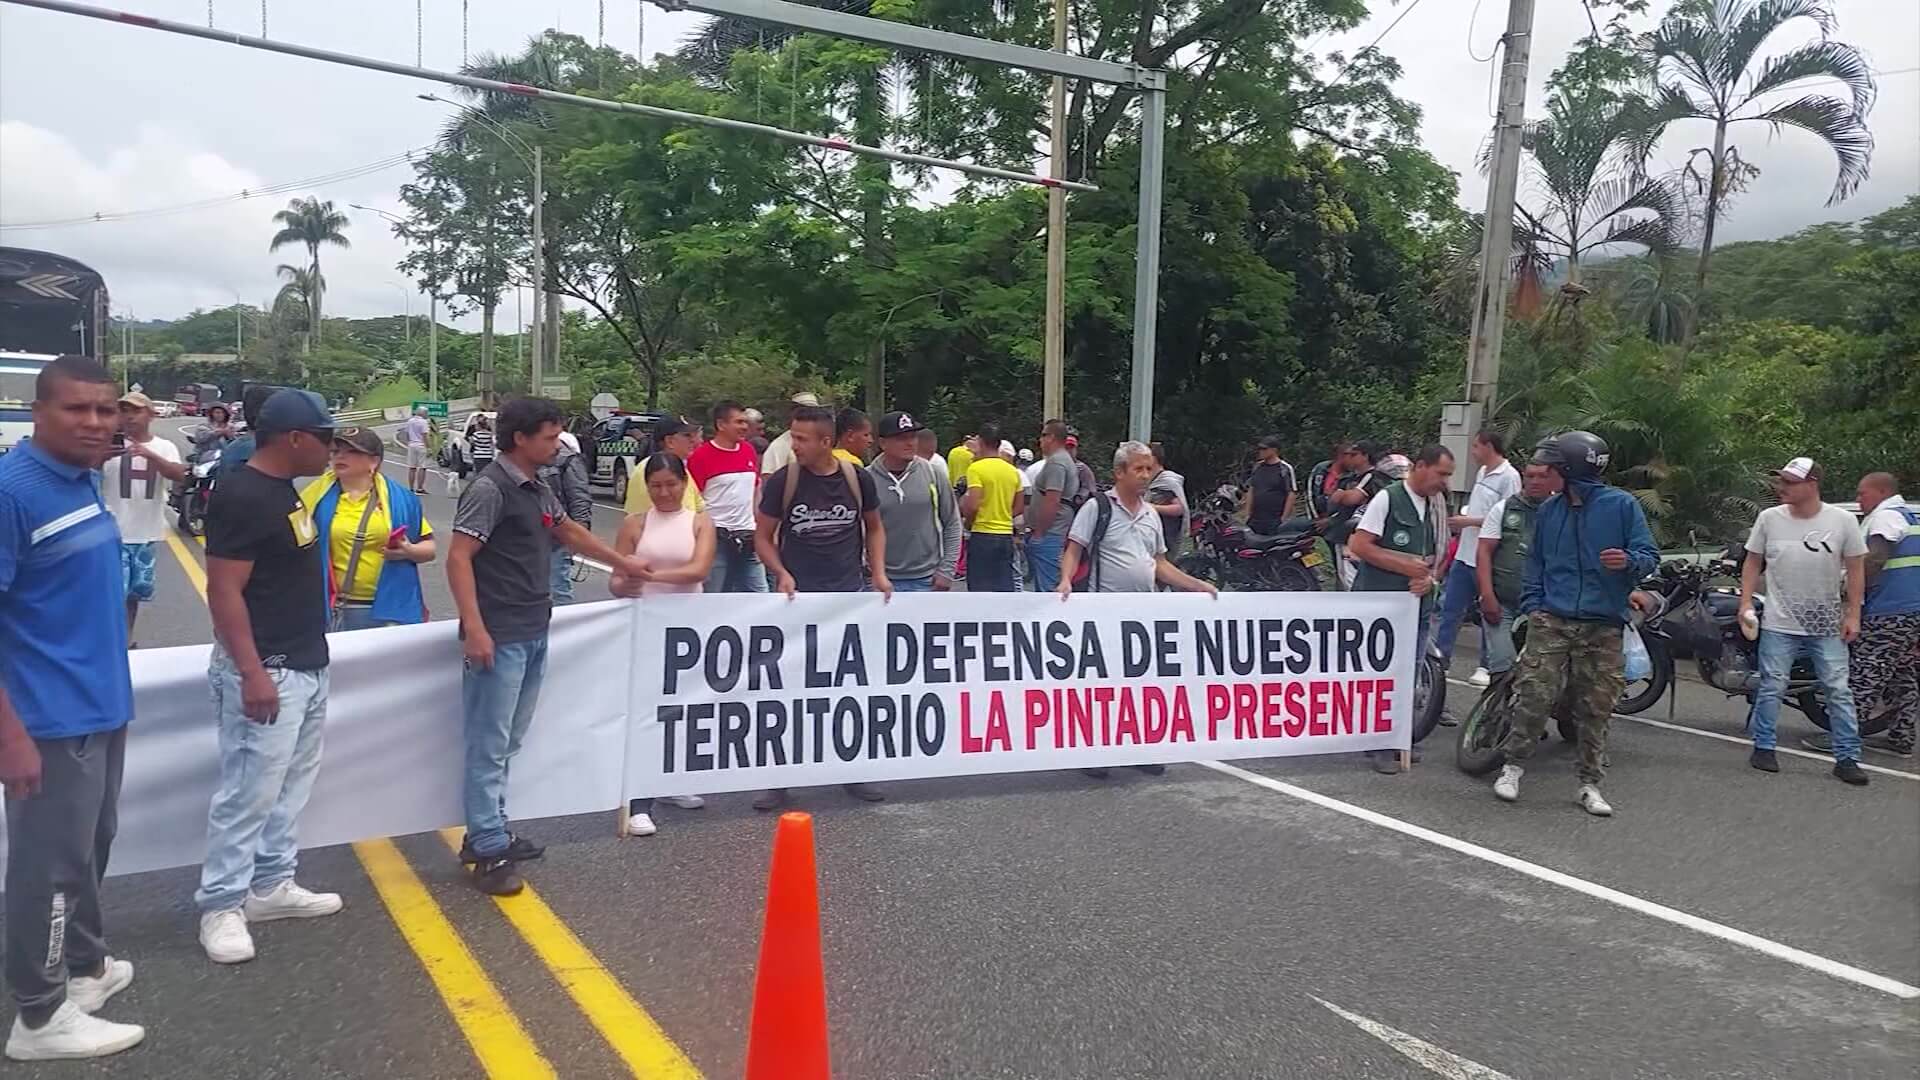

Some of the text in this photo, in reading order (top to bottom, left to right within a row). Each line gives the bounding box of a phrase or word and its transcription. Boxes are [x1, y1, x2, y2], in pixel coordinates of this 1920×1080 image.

[663, 617, 1395, 695] POR LA DEFENSA DE NUESTRO
[656, 678, 1395, 774] TERRITORIO LA PINTADA PRESENTE
